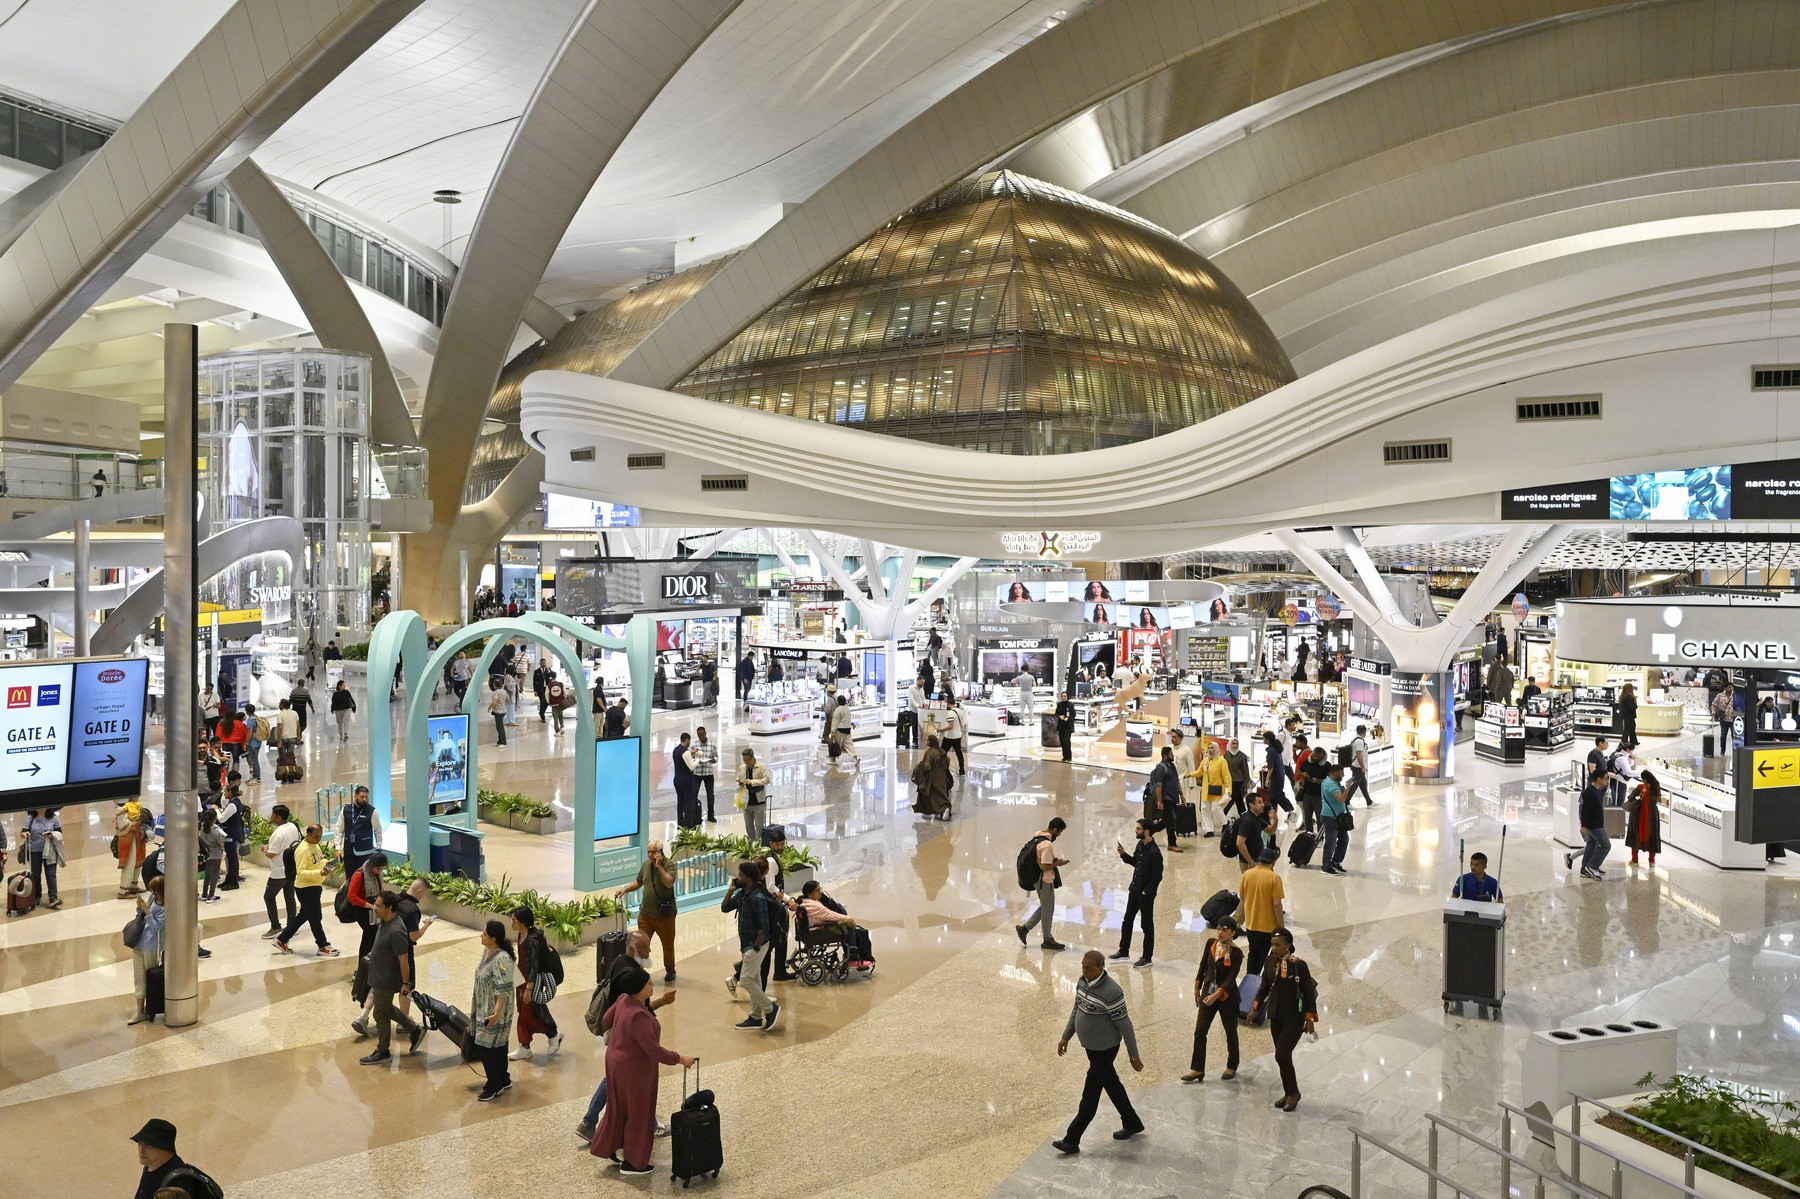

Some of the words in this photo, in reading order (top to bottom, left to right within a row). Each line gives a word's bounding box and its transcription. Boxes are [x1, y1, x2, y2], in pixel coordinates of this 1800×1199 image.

[1745, 478, 1786, 488] narciso
[1513, 493, 1548, 502] narciso
[1550, 492, 1597, 502] rodriguez
[1003, 534, 1017, 543] Abu
[1006, 543, 1022, 553] duty
[665, 575, 709, 598] DIOR
[791, 583, 826, 591] CLARINS
[572, 615, 595, 625] DIOR
[980, 625, 1009, 633] GUERLAIN
[998, 640, 1016, 649] TOM
[1016, 639, 1039, 648] FORD
[1681, 641, 1796, 661] CHANEL
[1361, 660, 1377, 673] LAUDER
[40, 689, 58, 698] jones
[84, 720, 118, 735] GATE
[121, 718, 131, 732] D
[7, 726, 43, 743] GATE
[46, 725, 57, 740] A
[435, 760, 457, 768] Explore
[599, 866, 612, 874] Find
[611, 864, 624, 873] your
[624, 862, 637, 871] pace
